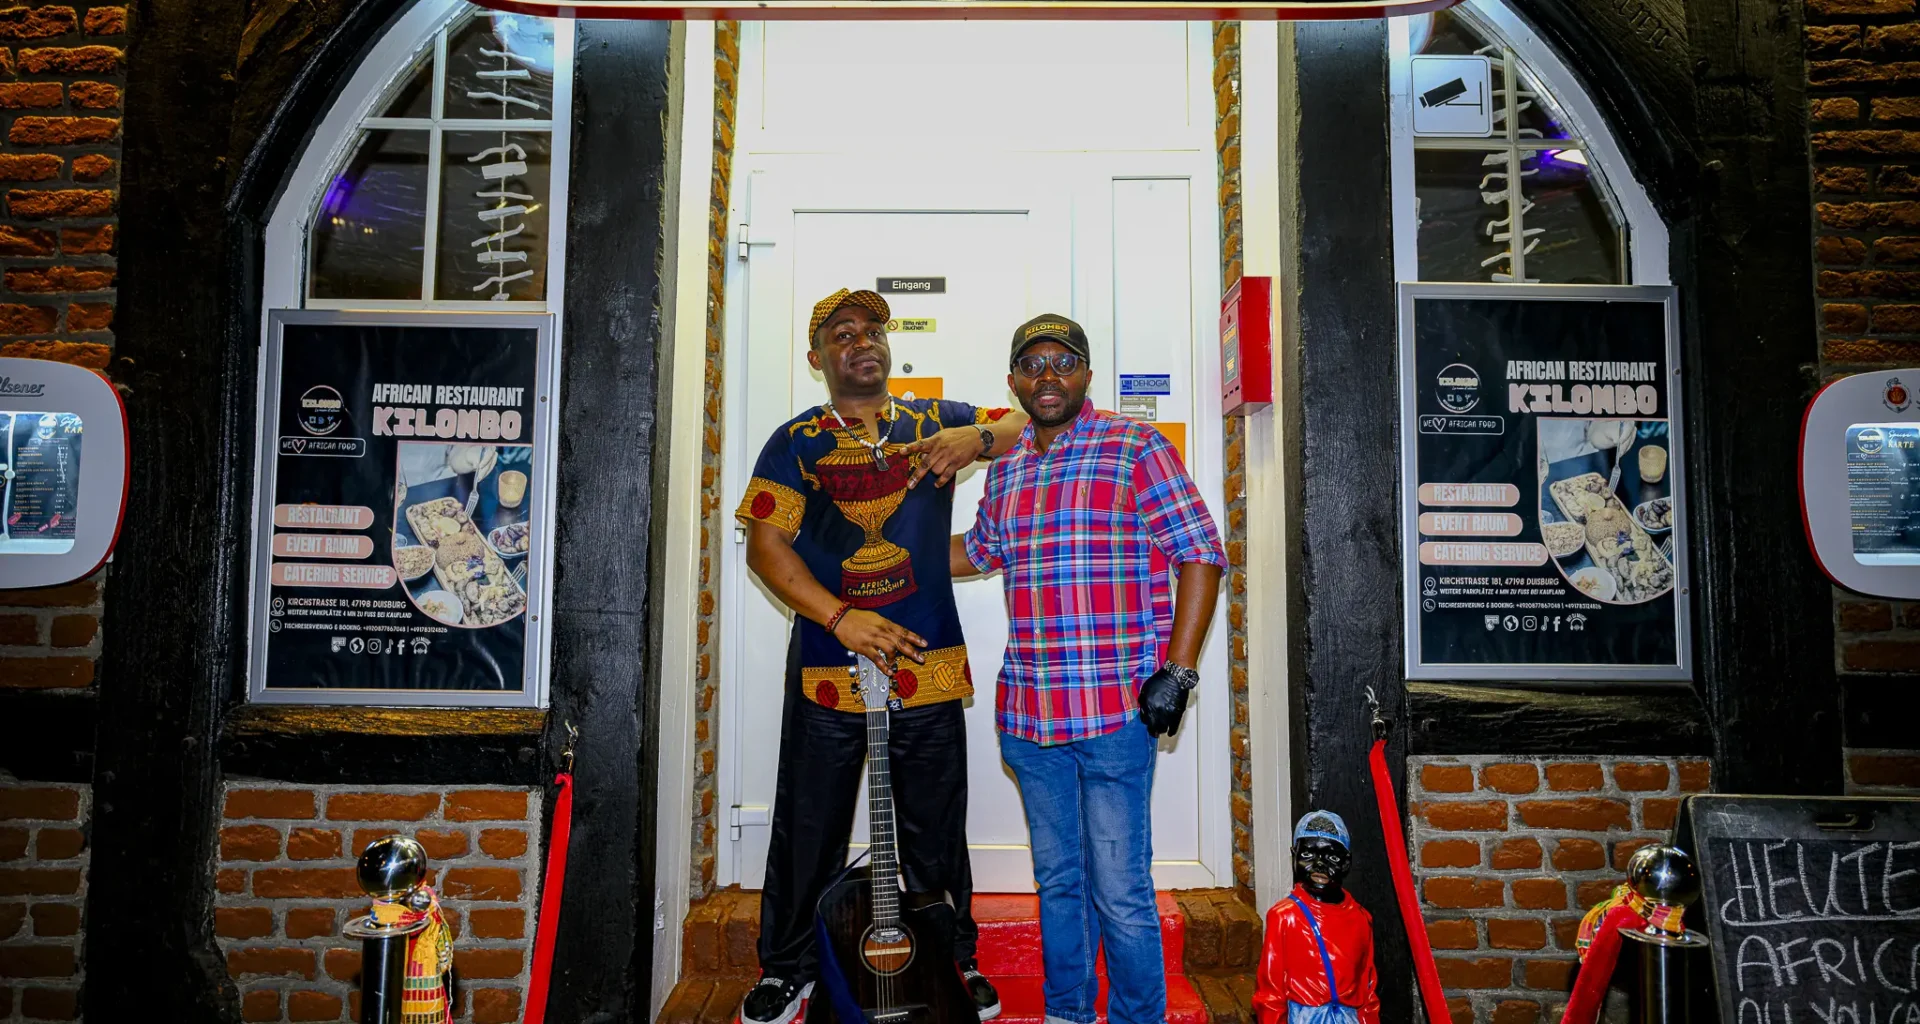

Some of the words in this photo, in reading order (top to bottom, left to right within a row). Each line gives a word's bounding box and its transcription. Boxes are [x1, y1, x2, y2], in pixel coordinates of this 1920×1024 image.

[892, 280, 931, 290] Eingang
[1026, 324, 1068, 334] KILOMBO
[1506, 360, 1565, 380] AFRICAN
[1569, 362, 1656, 381] RESTAURANT
[372, 383, 432, 404] AFRICAN
[435, 385, 524, 406] RESTAURANT
[1508, 383, 1657, 415] KILOMBO
[372, 406, 522, 440] KILOMBO
[1448, 420, 1476, 428] AFRICAN
[308, 442, 336, 450] AFRICAN
[338, 442, 357, 451] FOOD
[1434, 486, 1507, 502] RESTAURANT
[288, 506, 361, 524] RESTAURANT
[1434, 516, 1469, 531] EVENT
[1472, 516, 1508, 531] RAUM
[286, 536, 322, 552] EVENT
[325, 537, 359, 554] RAUM
[1434, 545, 1489, 560] CATERING
[1493, 546, 1540, 561] SERVICE
[284, 566, 339, 582] CATERING
[342, 567, 390, 584] SERVICE
[1440, 577, 1489, 585] KIRCHSTRASSE
[847, 579, 905, 596] CHAMPIONSHIP
[861, 578, 890, 589] AFRICA
[287, 598, 337, 607] KIRCHSTRASSE
[351, 600, 371, 608] 47198
[372, 601, 406, 609] DUISBURG
[1728, 838, 1920, 920] HEUTE
